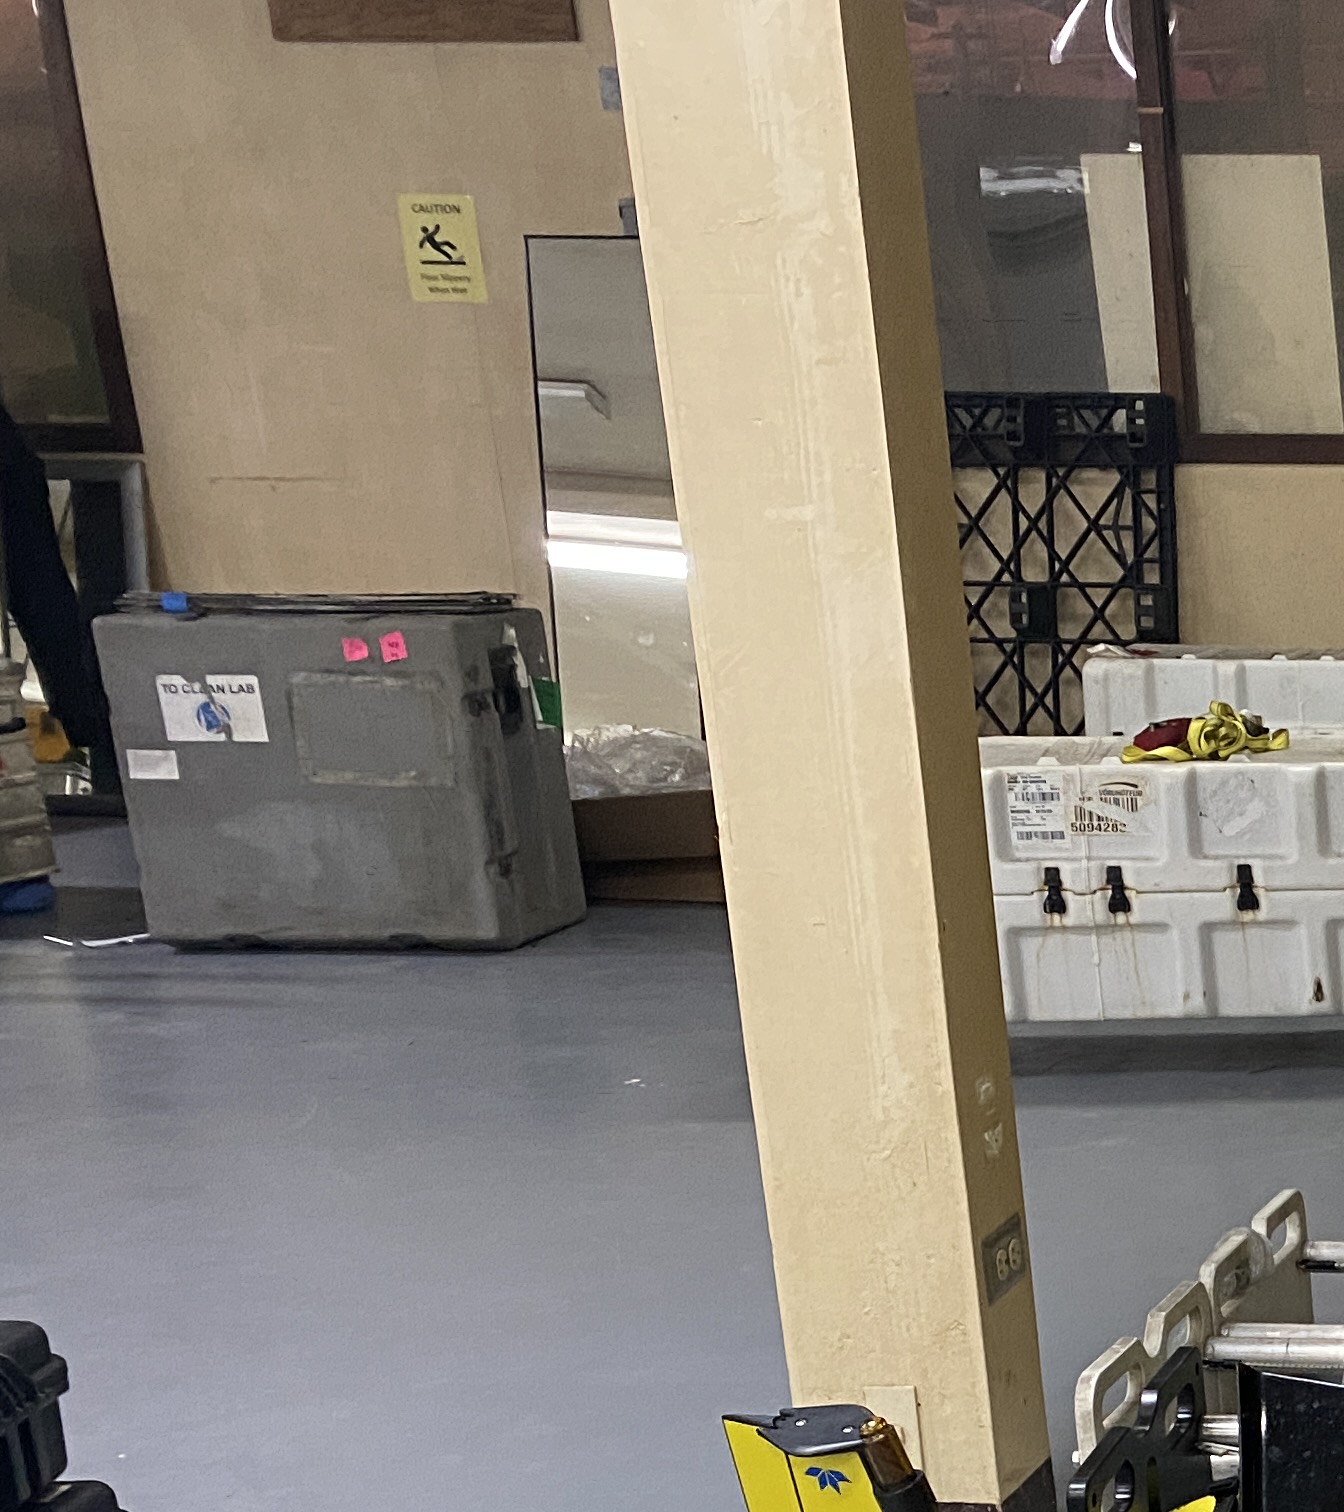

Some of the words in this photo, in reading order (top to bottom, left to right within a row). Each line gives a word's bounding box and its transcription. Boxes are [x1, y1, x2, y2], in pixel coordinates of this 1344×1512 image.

[410, 203, 461, 214] CAUTION
[160, 683, 178, 694] TO
[181, 683, 227, 694] CLAN
[228, 683, 256, 694] LAB
